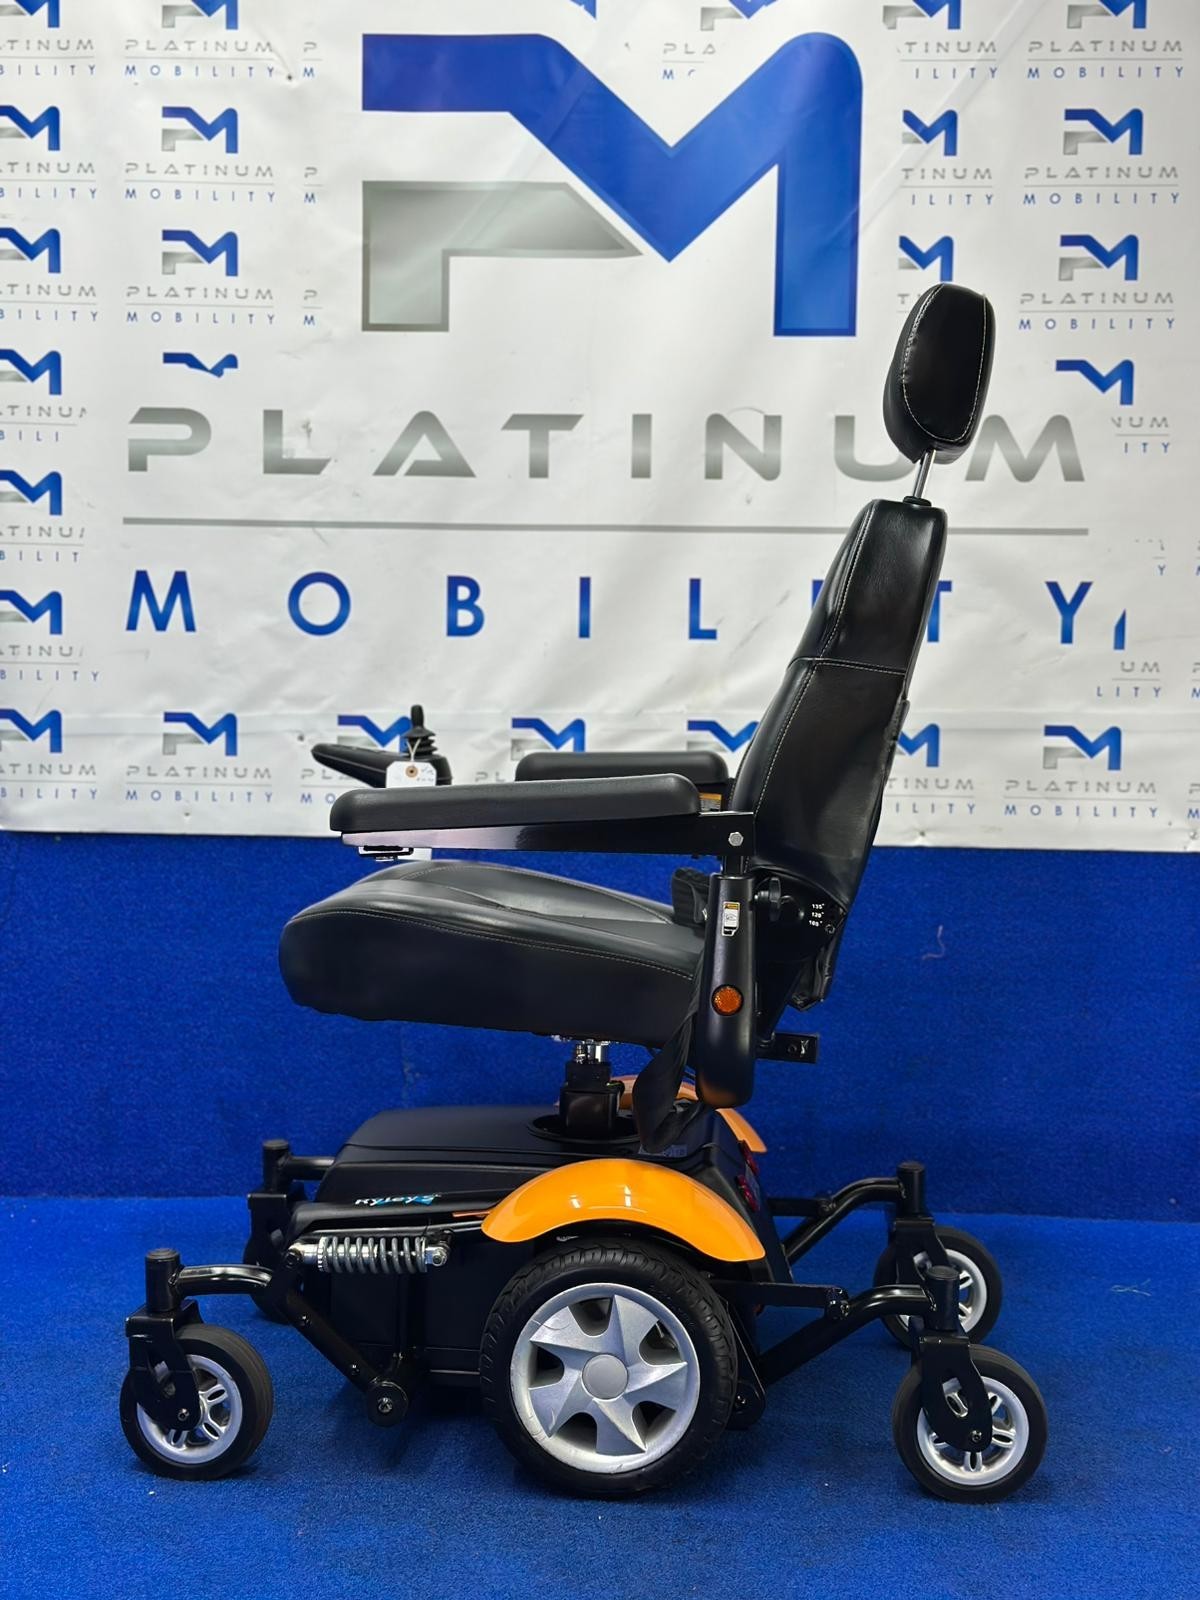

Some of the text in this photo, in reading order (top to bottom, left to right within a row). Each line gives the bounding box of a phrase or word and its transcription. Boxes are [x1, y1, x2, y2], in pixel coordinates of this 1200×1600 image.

[0, 40, 93, 51] TINUM
[125, 40, 274, 52] PLATINUM
[897, 41, 997, 53] TINUM
[1029, 40, 1182, 52] PLATINUM
[125, 65, 274, 77] MOBILITY
[1027, 66, 1183, 78] MOBILITY
[0, 162, 94, 173] TINUM
[125, 163, 273, 177] PLATINUM
[1025, 166, 1178, 178] PLATINUM
[125, 188, 275, 202] MOBILITY
[1023, 192, 1179, 204] MOBILITY
[0, 284, 96, 297] TINUM
[126, 286, 273, 299] PLATINUM
[1021, 292, 1173, 304] PLATINUM
[126, 311, 274, 324] MOBILITY
[1019, 318, 1175, 329] MOBILITY
[128, 407, 1086, 483] PLATINUM
[125, 569, 1094, 646] MOBILTY
[127, 766, 271, 778] PLATINUM
[1006, 780, 1155, 793] PLATINUM
[125, 790, 272, 802] MOBILITY
[1004, 804, 1157, 817] MOBILITY
